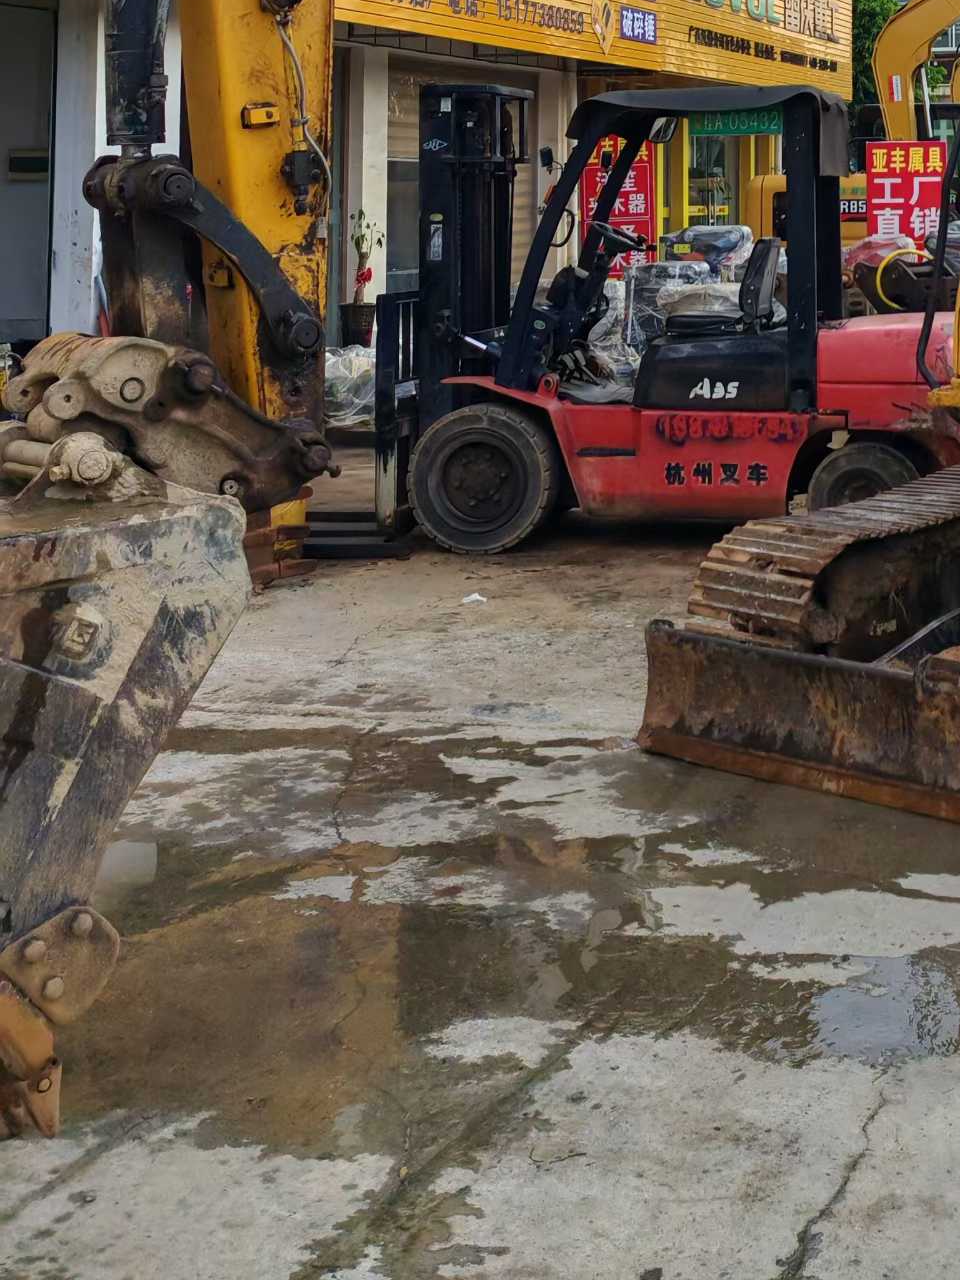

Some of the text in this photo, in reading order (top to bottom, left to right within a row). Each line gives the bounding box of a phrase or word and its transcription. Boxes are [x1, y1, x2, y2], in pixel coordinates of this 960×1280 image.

[622, 9, 656, 42] 破碎锤
[871, 147, 943, 174] 亚丰属具
[872, 176, 942, 205] 工厂
[871, 207, 941, 238] 直销
[664, 462, 769, 487] 杭州叉车
